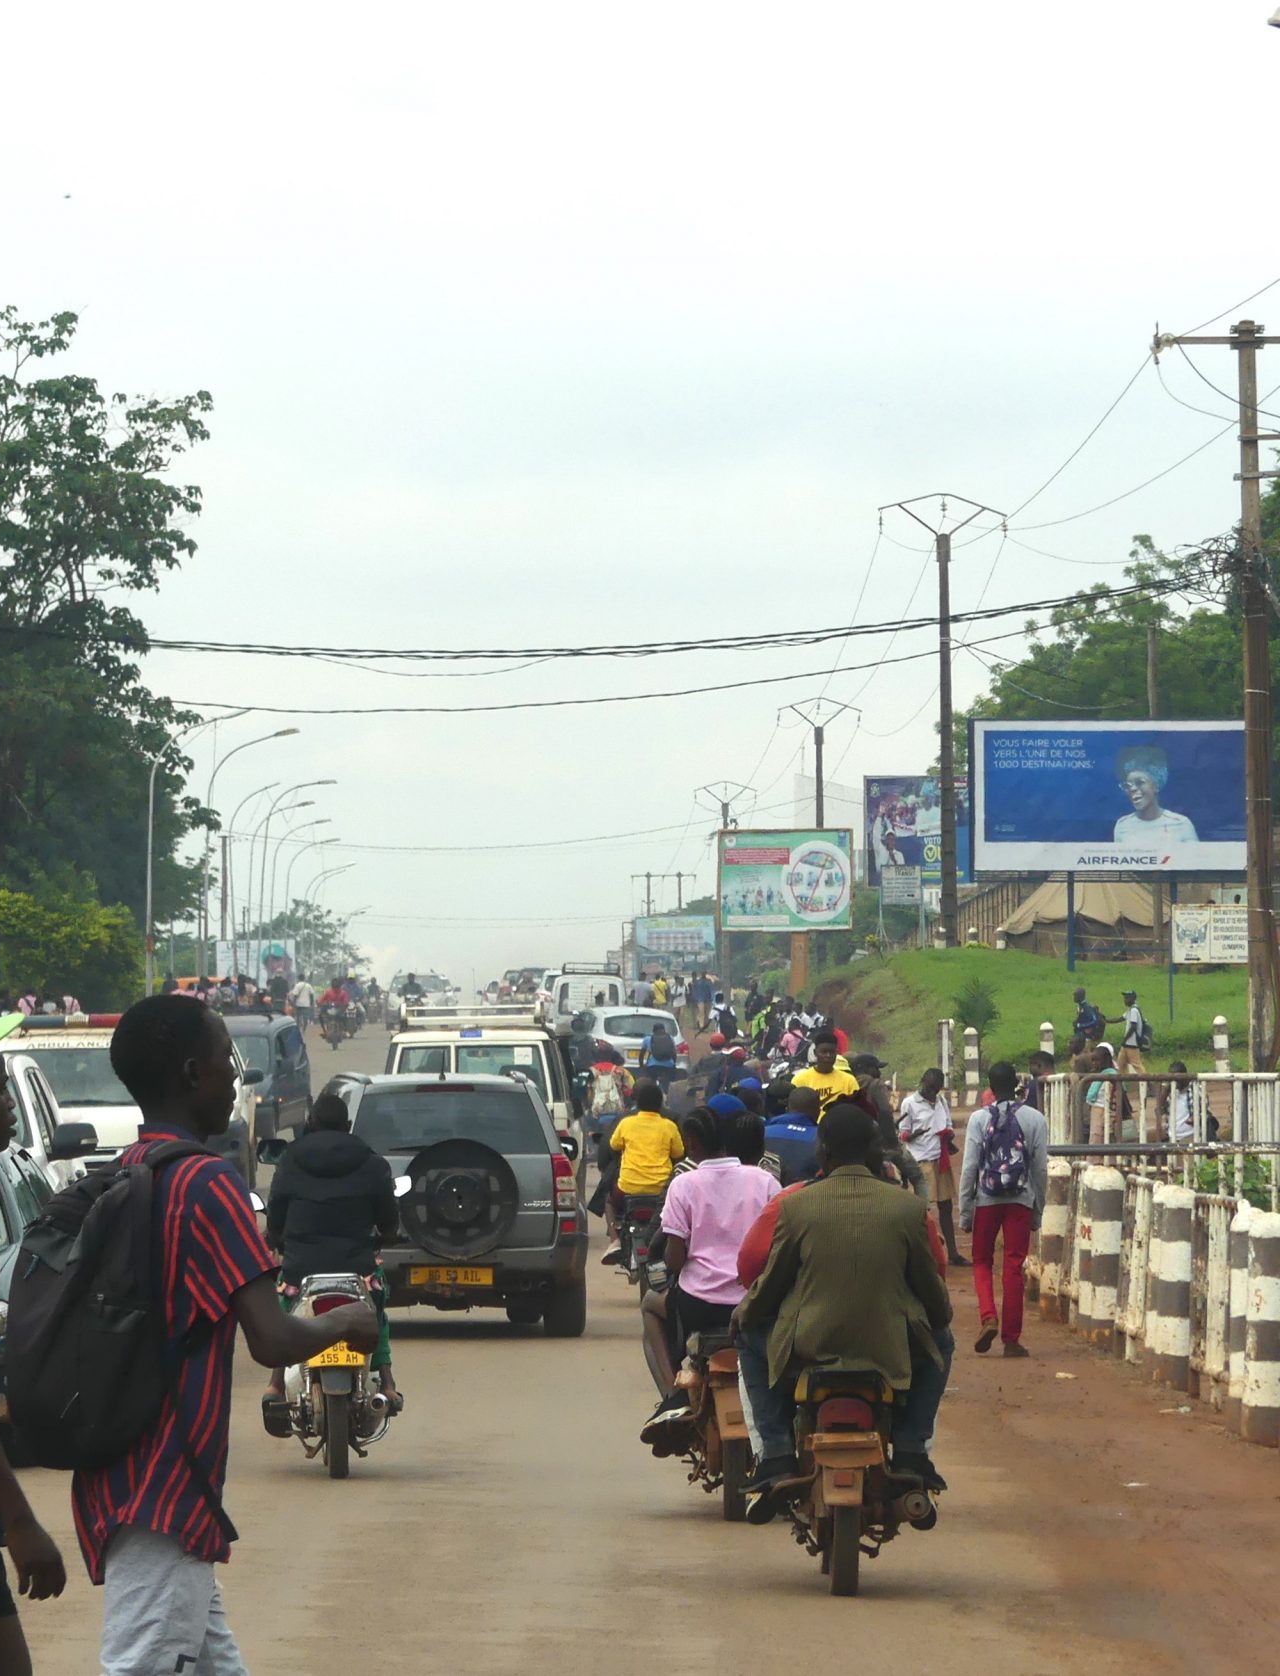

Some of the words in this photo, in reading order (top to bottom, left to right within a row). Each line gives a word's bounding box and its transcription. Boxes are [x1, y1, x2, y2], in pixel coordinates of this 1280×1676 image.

[993, 739, 1020, 748] VOUS
[1022, 739, 1050, 748] FAIRE
[1053, 739, 1084, 748] VOLER
[993, 750, 1018, 759] VERS
[1020, 750, 1048, 759] L'UNE
[1050, 750, 1063, 759] DE
[1065, 750, 1087, 759] NOS
[993, 760, 1020, 769] 1000
[1077, 856, 1158, 865] AIRFRANCE
[320, 1353, 339, 1364] 155
[346, 1353, 359, 1364] AH
